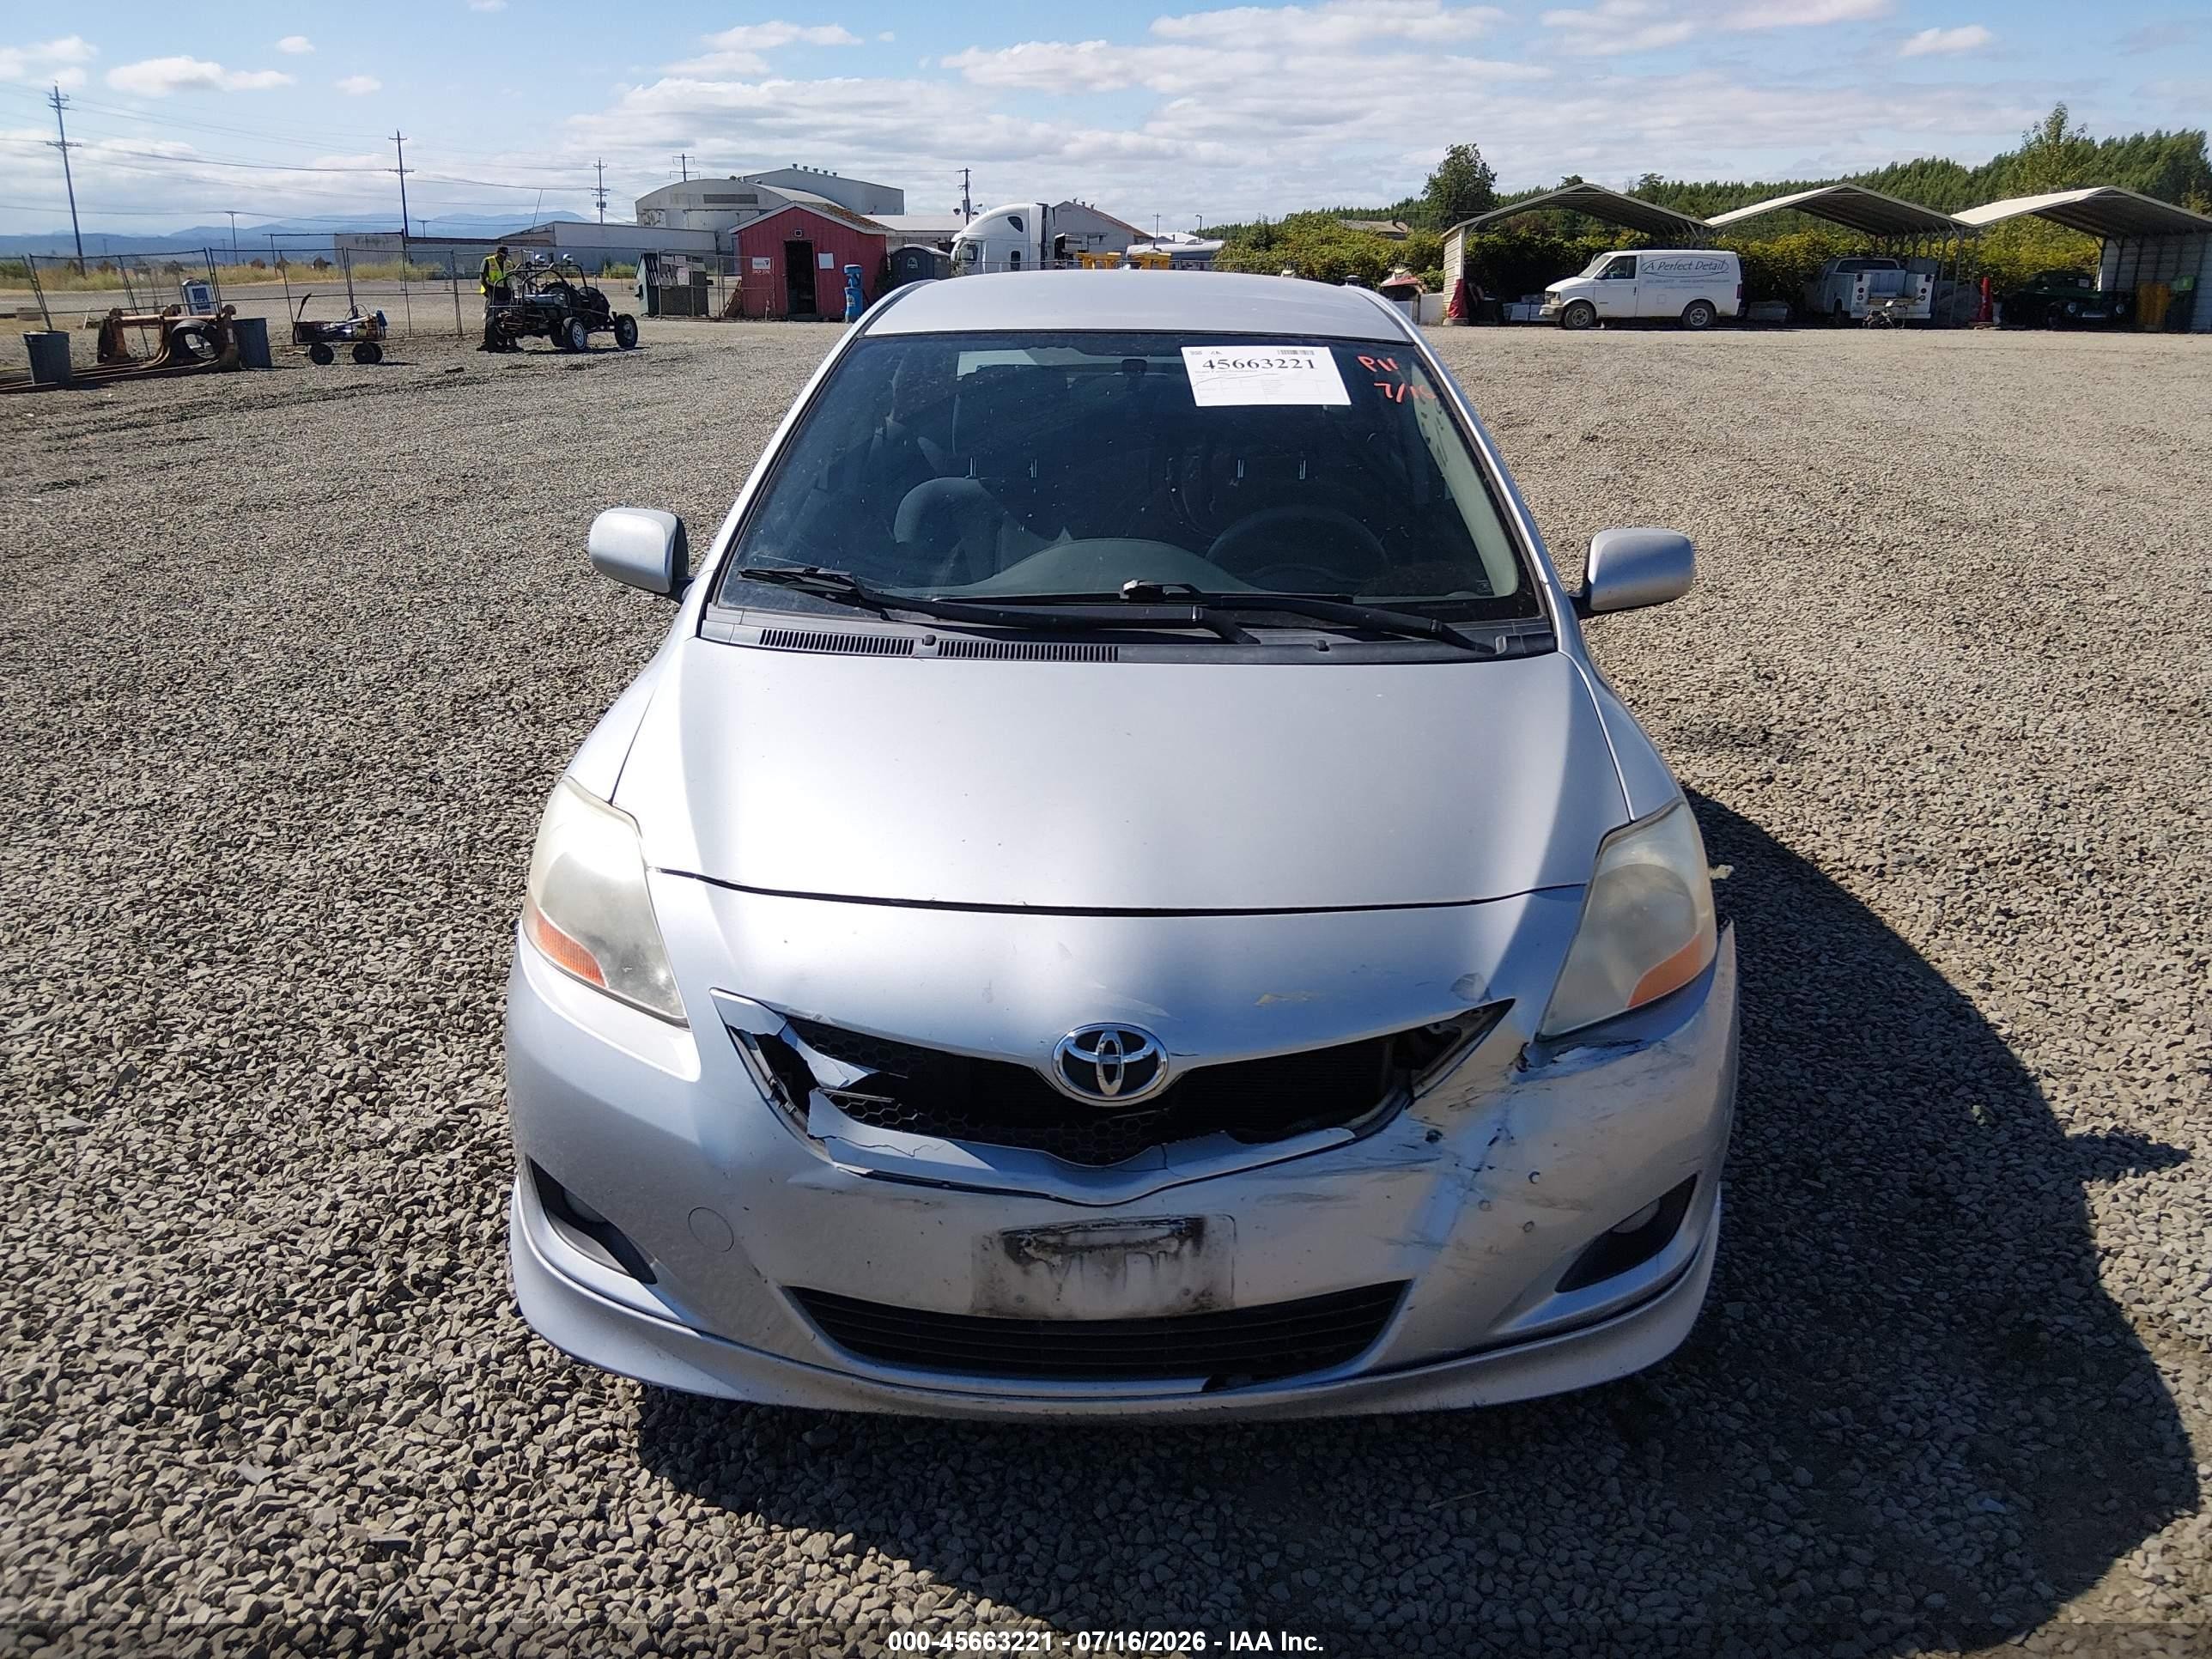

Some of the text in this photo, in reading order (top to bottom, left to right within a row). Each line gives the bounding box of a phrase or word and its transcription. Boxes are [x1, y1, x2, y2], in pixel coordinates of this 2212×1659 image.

[1657, 258, 1693, 270] Perfect
[1695, 259, 1726, 270] Detail
[1202, 358, 1316, 370] 45663221
